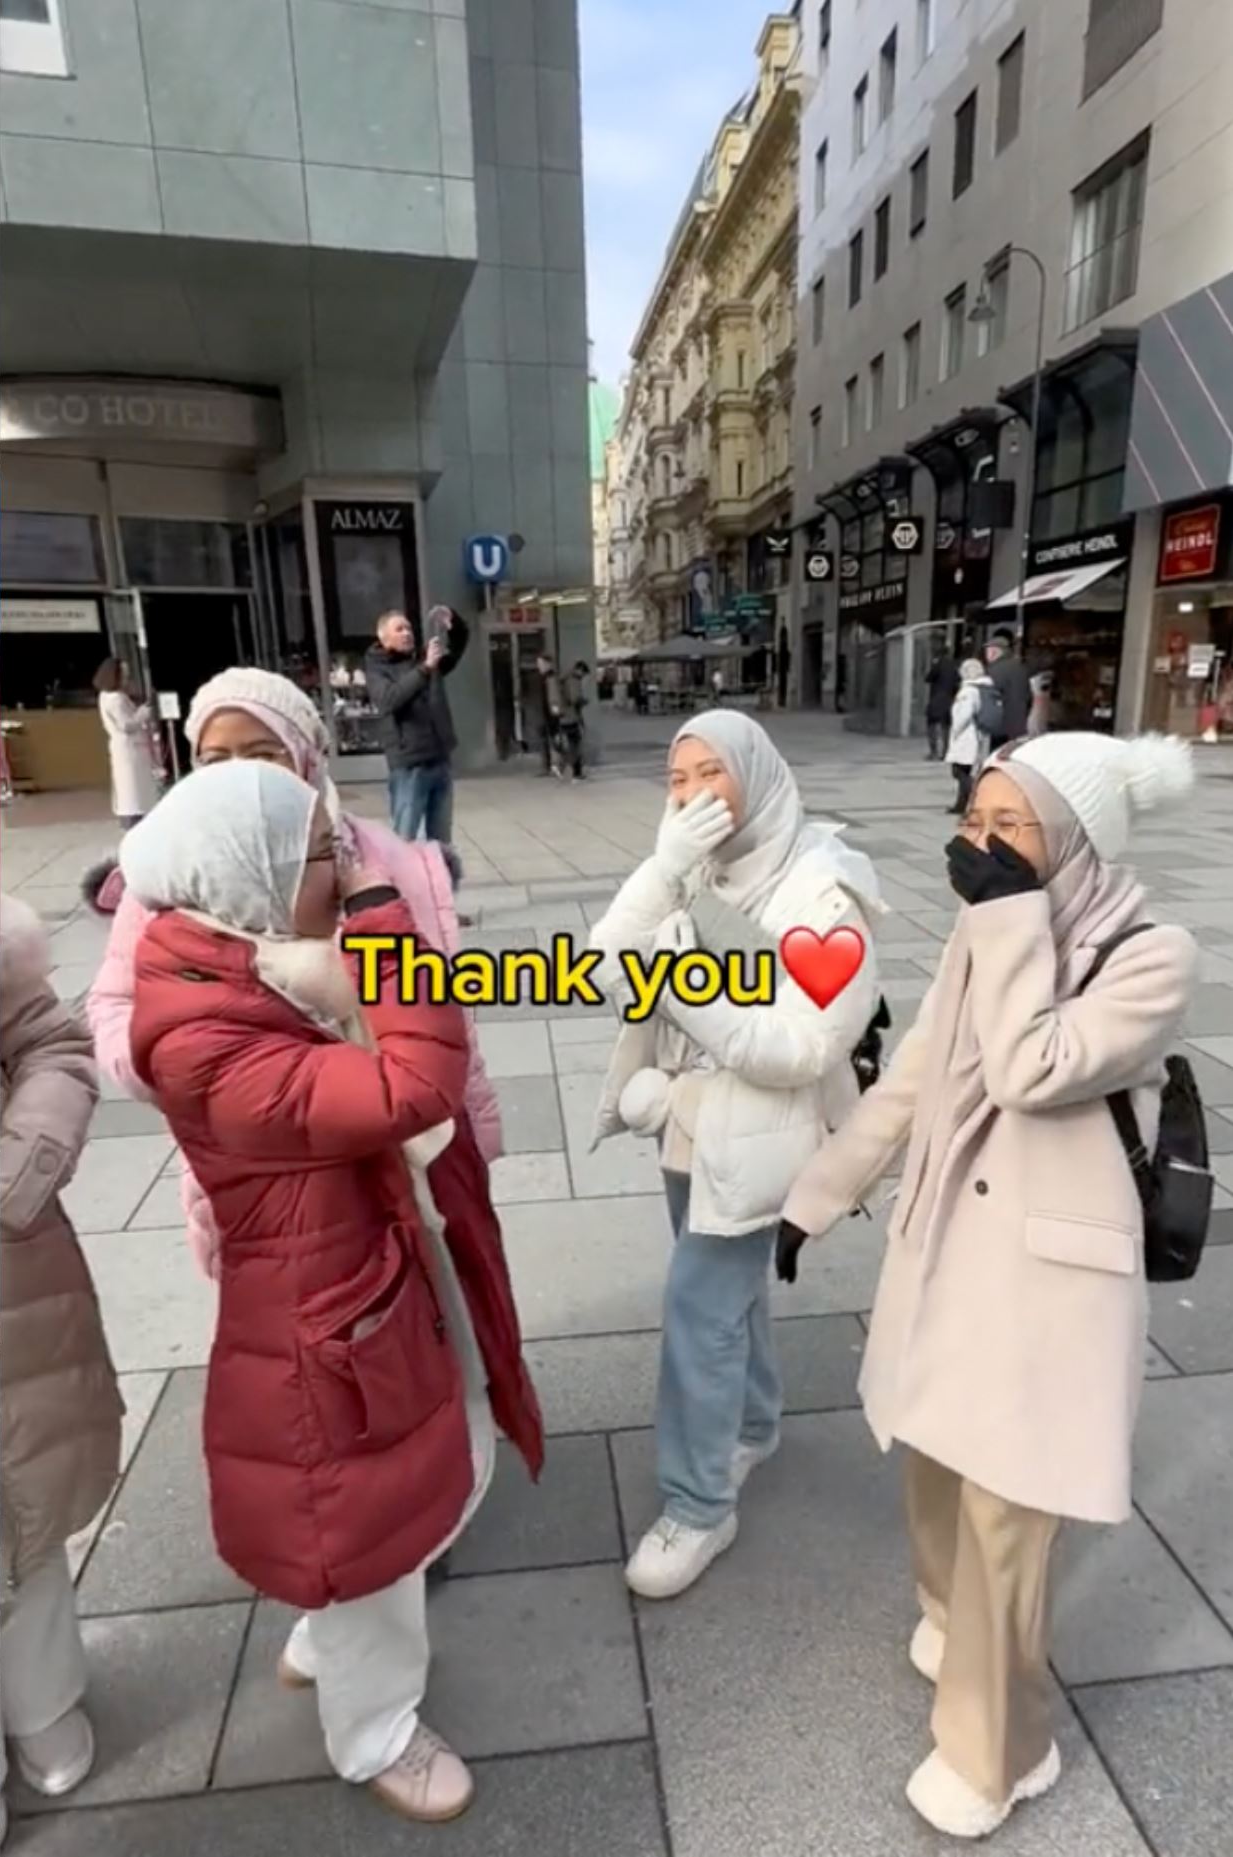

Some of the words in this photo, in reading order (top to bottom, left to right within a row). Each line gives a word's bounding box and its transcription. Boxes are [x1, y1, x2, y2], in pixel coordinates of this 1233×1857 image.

[330, 508, 404, 531] ALMAZ
[1165, 532, 1213, 553] HEINDL
[472, 543, 502, 577] U
